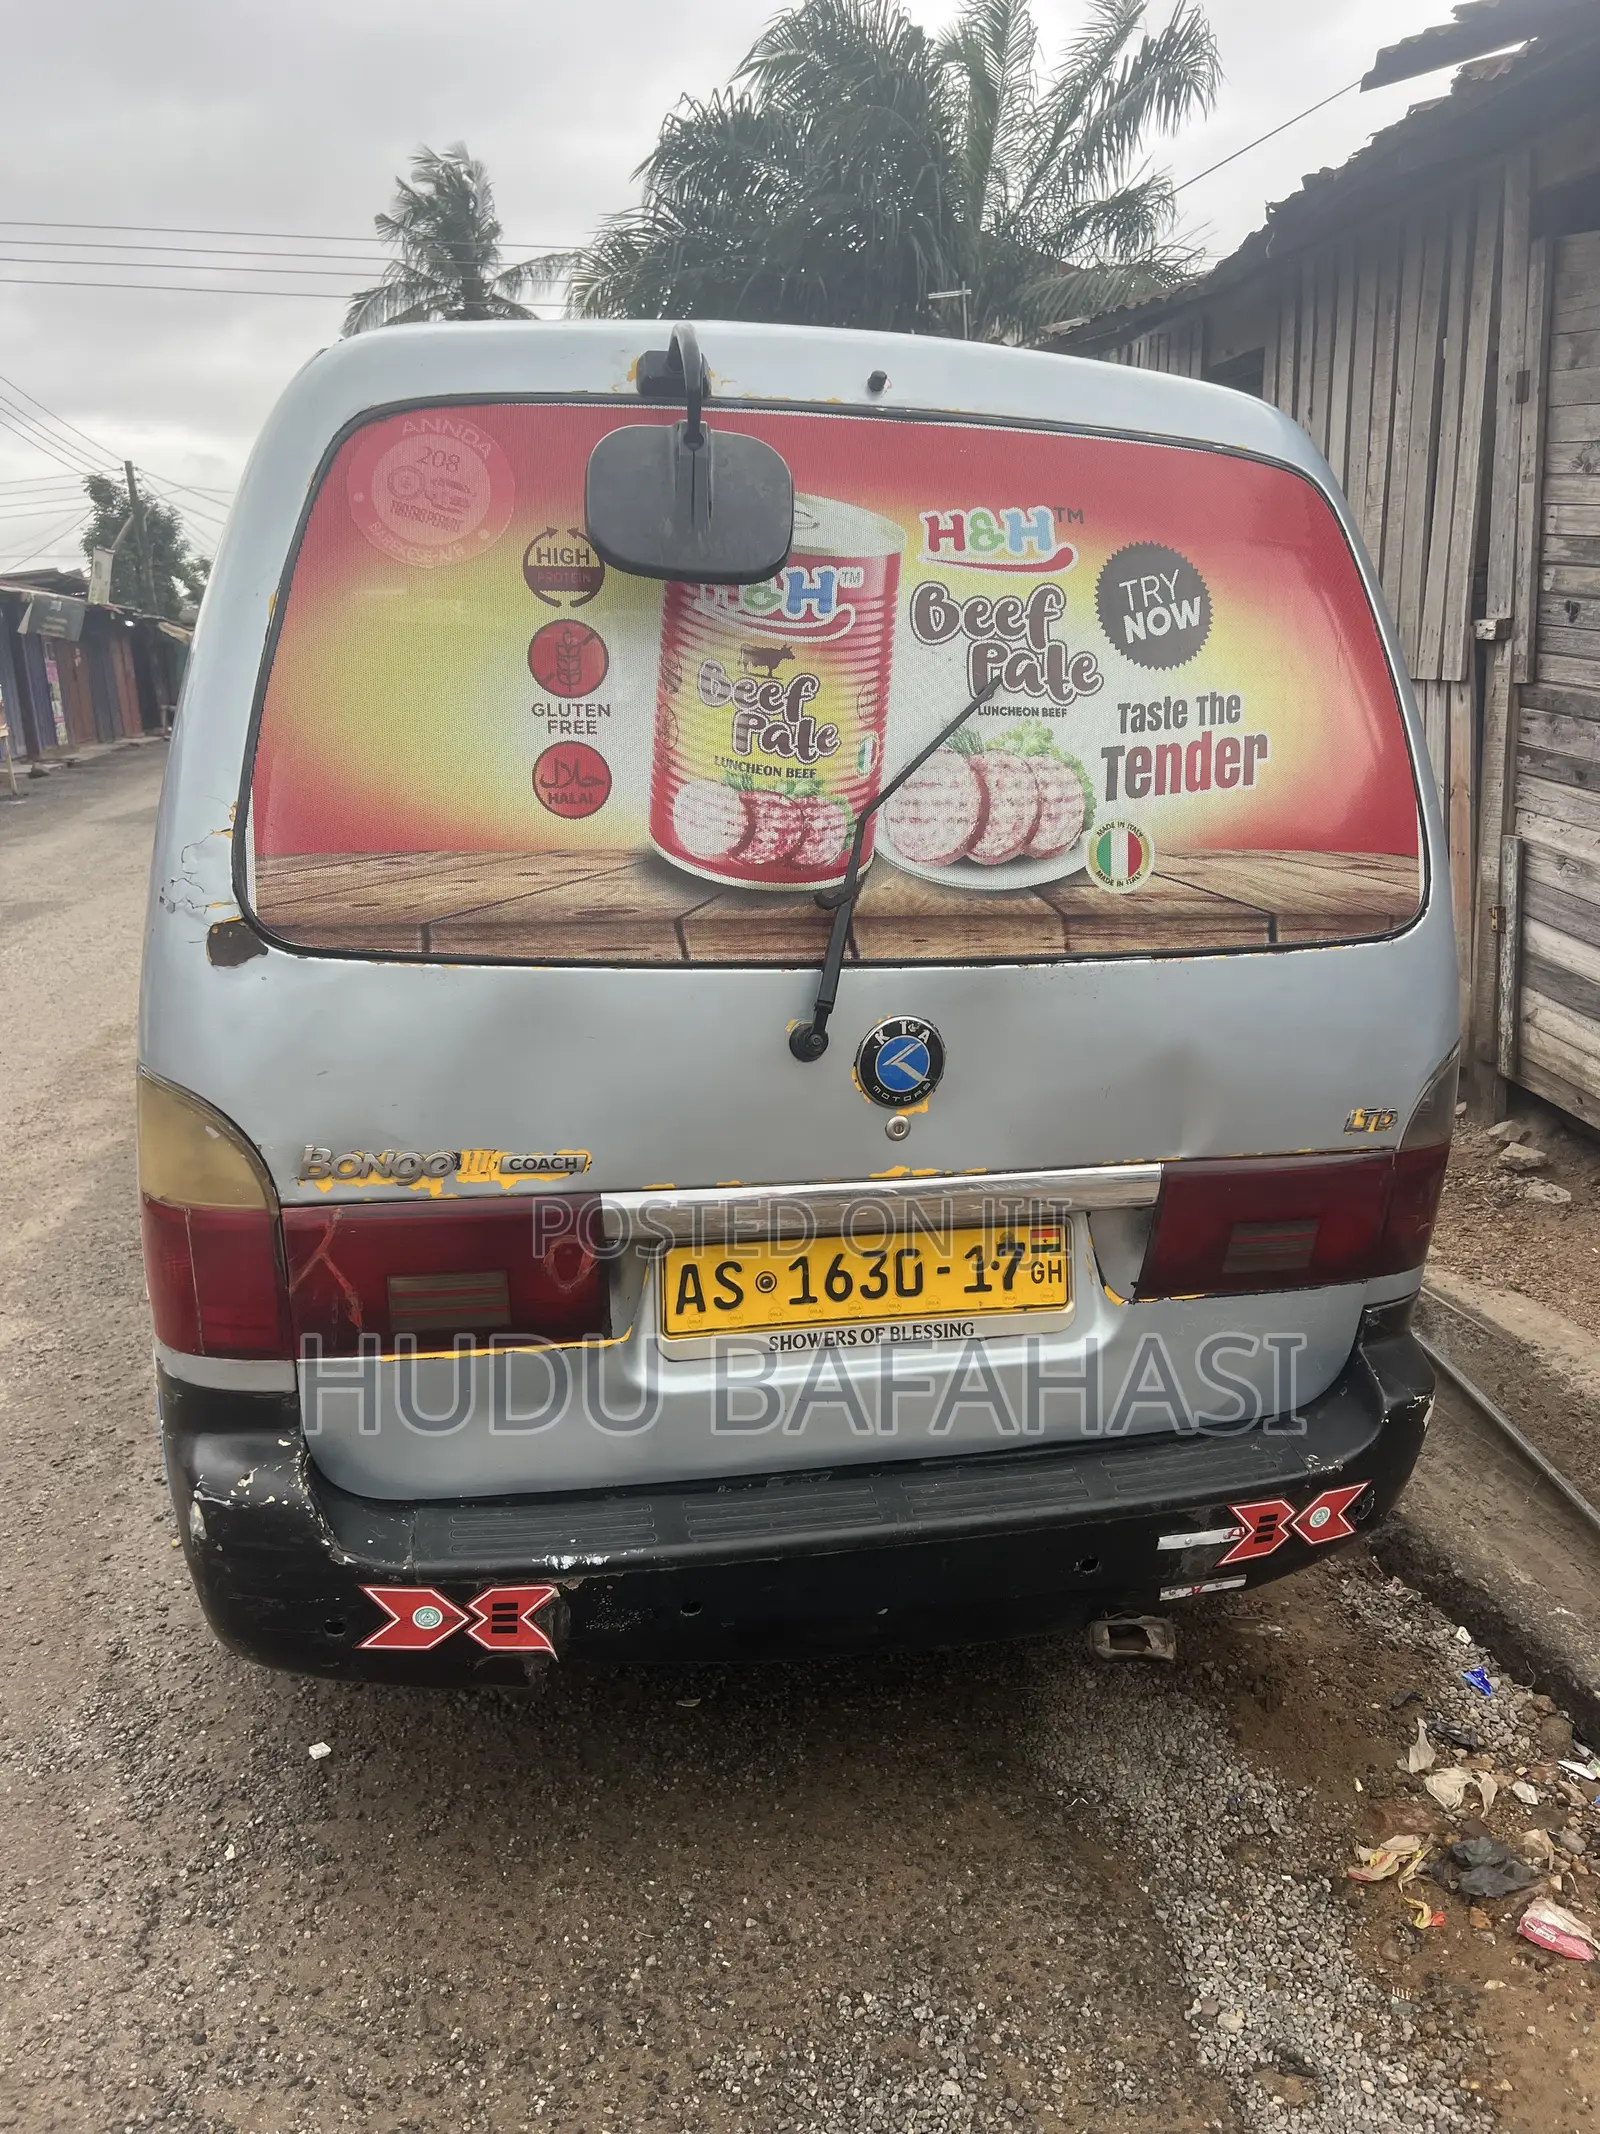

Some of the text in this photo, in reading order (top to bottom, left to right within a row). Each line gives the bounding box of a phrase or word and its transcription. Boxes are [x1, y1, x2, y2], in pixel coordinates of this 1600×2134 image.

[416, 446, 461, 473] 208
[920, 507, 1054, 555] H&H
[536, 547, 590, 566] HIGH
[537, 571, 592, 583] PROTEIN
[1118, 569, 1180, 611] TRY
[910, 581, 1066, 653] Beef
[1123, 597, 1201, 644] NOW
[698, 659, 821, 724] Beef
[531, 702, 611, 717] GLUTEN
[977, 705, 1067, 718] LUNCHEON BEEF
[1117, 691, 1241, 734] Taste The
[547, 720, 598, 735] FREE
[714, 755, 817, 779] LUNCHEON BEEF
[1101, 731, 1268, 802] Tender
[547, 792, 599, 805] HALAL
[1096, 821, 1116, 837] MADE
[1126, 823, 1144, 838] ITALY
[1095, 870, 1115, 887] MADE
[1125, 870, 1142, 886] ITALY
[873, 1020, 931, 1046] KIA
[872, 1082, 931, 1102] MOTORS
[508, 1156, 578, 1171] COACH
[1030, 1259, 1063, 1285] GH
[675, 1261, 744, 1315] AS
[769, 1321, 975, 1351] SHOWERS OF BLESSING
